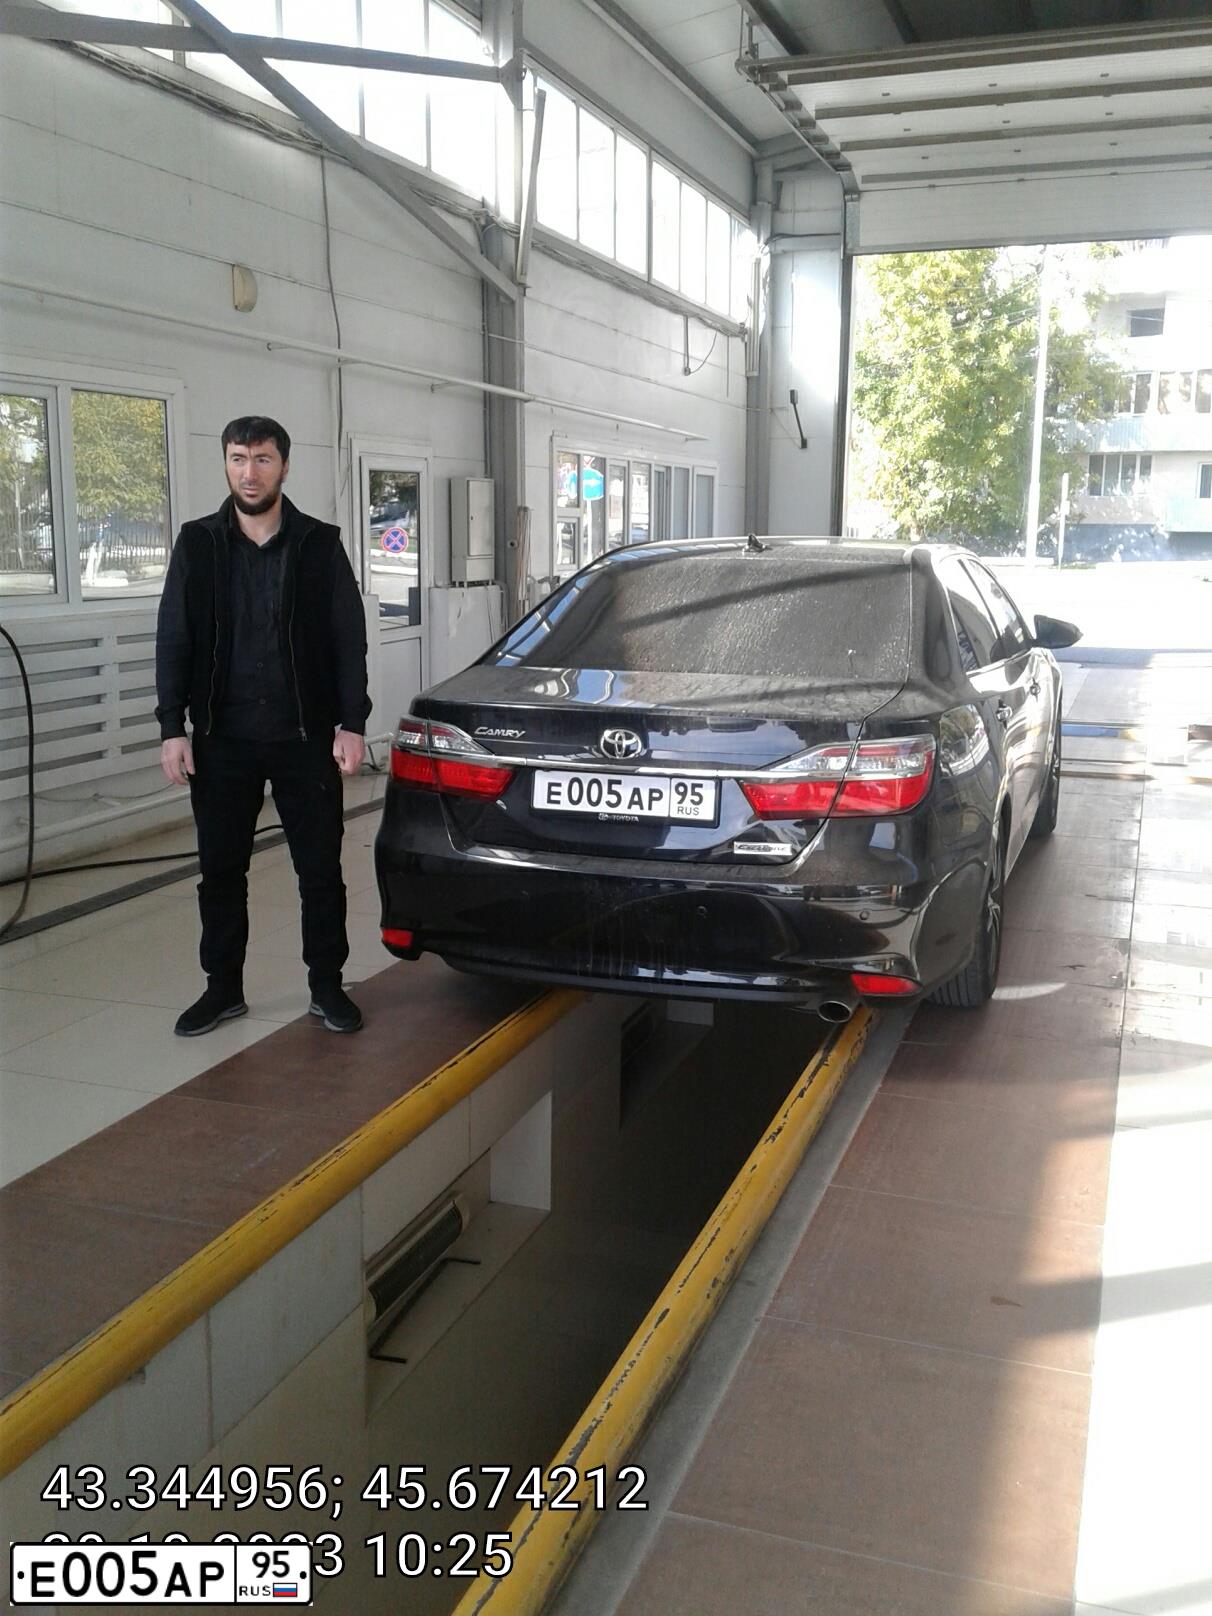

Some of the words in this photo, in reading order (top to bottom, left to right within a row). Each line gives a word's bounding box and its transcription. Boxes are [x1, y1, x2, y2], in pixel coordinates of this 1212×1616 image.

[474, 726, 525, 739] CAMRY
[675, 782, 703, 805] 95
[677, 806, 700, 816] RUS
